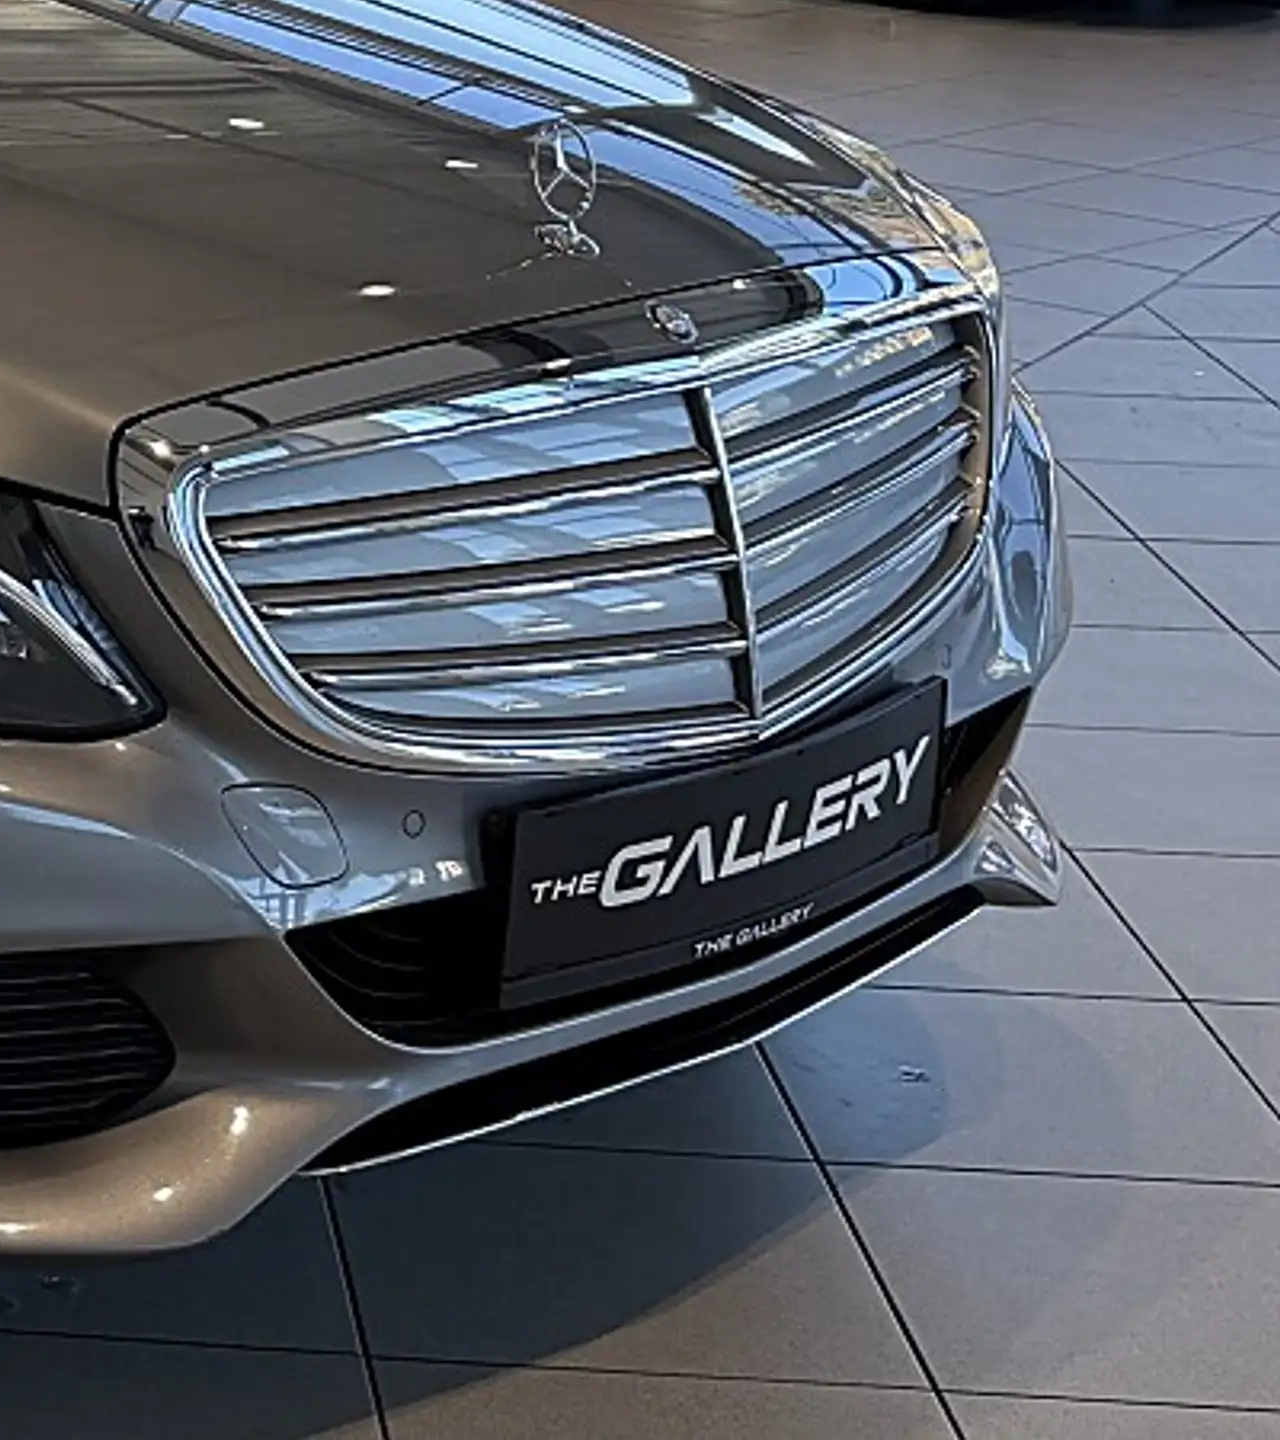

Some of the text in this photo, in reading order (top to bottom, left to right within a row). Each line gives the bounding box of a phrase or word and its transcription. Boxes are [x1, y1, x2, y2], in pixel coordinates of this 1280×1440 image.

[530, 735, 931, 908] THE GALLERY
[693, 902, 815, 959] THE GALLERY
